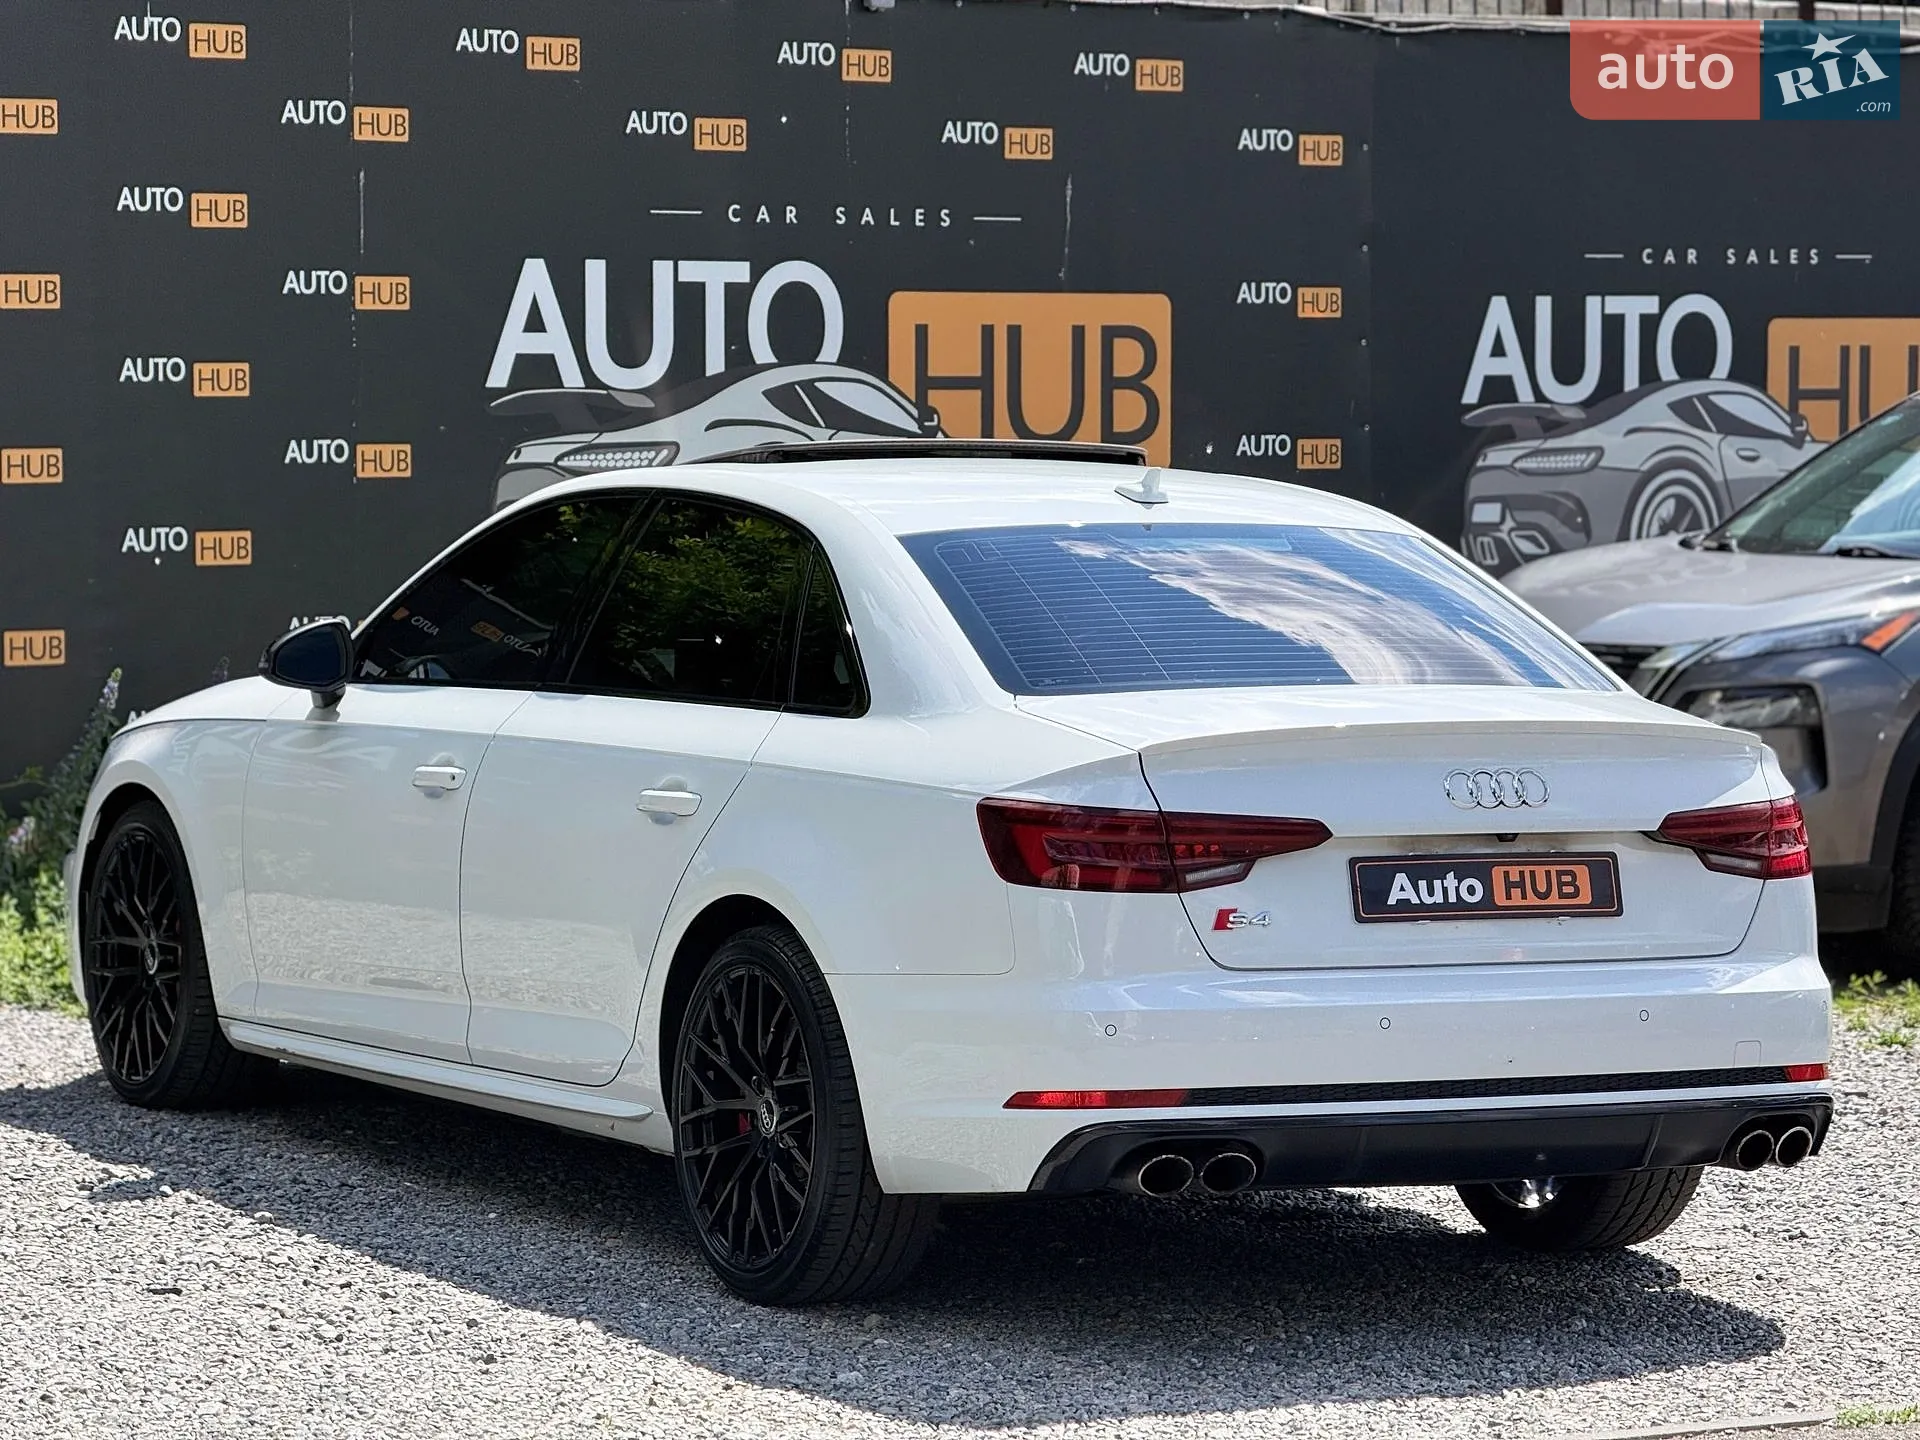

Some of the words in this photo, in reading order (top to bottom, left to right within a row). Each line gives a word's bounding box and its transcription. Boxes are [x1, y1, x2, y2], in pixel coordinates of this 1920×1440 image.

[115, 17, 181, 41] AUTO
[195, 29, 243, 53] HUB
[456, 28, 519, 53] AUTO
[532, 42, 577, 65] HUB
[778, 42, 835, 65] AUTO
[847, 54, 889, 77] HUB
[1074, 53, 1129, 76] AUTO
[1140, 65, 1181, 87] HUB
[2, 104, 55, 128] HUB
[281, 100, 346, 124] AUTO
[359, 112, 406, 136] HUB
[626, 111, 687, 135] AUTO
[699, 124, 744, 146] HUB
[942, 121, 998, 144] AUTO
[1009, 133, 1050, 155] HUB
[1238, 129, 1293, 151] AUTO
[1303, 140, 1340, 161] HUB
[117, 187, 183, 211] AUTO
[197, 199, 245, 222] HUB
[728, 205, 797, 223] CAR
[836, 207, 951, 227] SALES
[1642, 249, 1696, 264] CAR
[1727, 249, 1819, 264] SALES
[5, 280, 57, 304] HUB
[283, 271, 347, 294] AUTO
[360, 282, 407, 305] HUB
[1237, 282, 1291, 304] AUTO
[1302, 293, 1339, 313] HUB
[485, 258, 844, 390] AUTO
[914, 324, 1160, 443] HUB
[1461, 294, 1733, 404] AUTO
[1788, 345, 1920, 437] HU
[120, 358, 185, 382] AUTO
[199, 368, 247, 391] HUB
[7, 454, 60, 478] HUB
[285, 439, 349, 463] AUTO
[361, 450, 408, 472] HUB
[1236, 435, 1290, 456] AUTO
[1301, 444, 1339, 464] HUB
[122, 527, 187, 551] AUTO
[201, 537, 249, 560] HUB
[10, 636, 62, 660] HUB
[1387, 871, 1483, 905] Auto
[1503, 870, 1581, 901] HUB
[1226, 911, 1272, 928] S4
